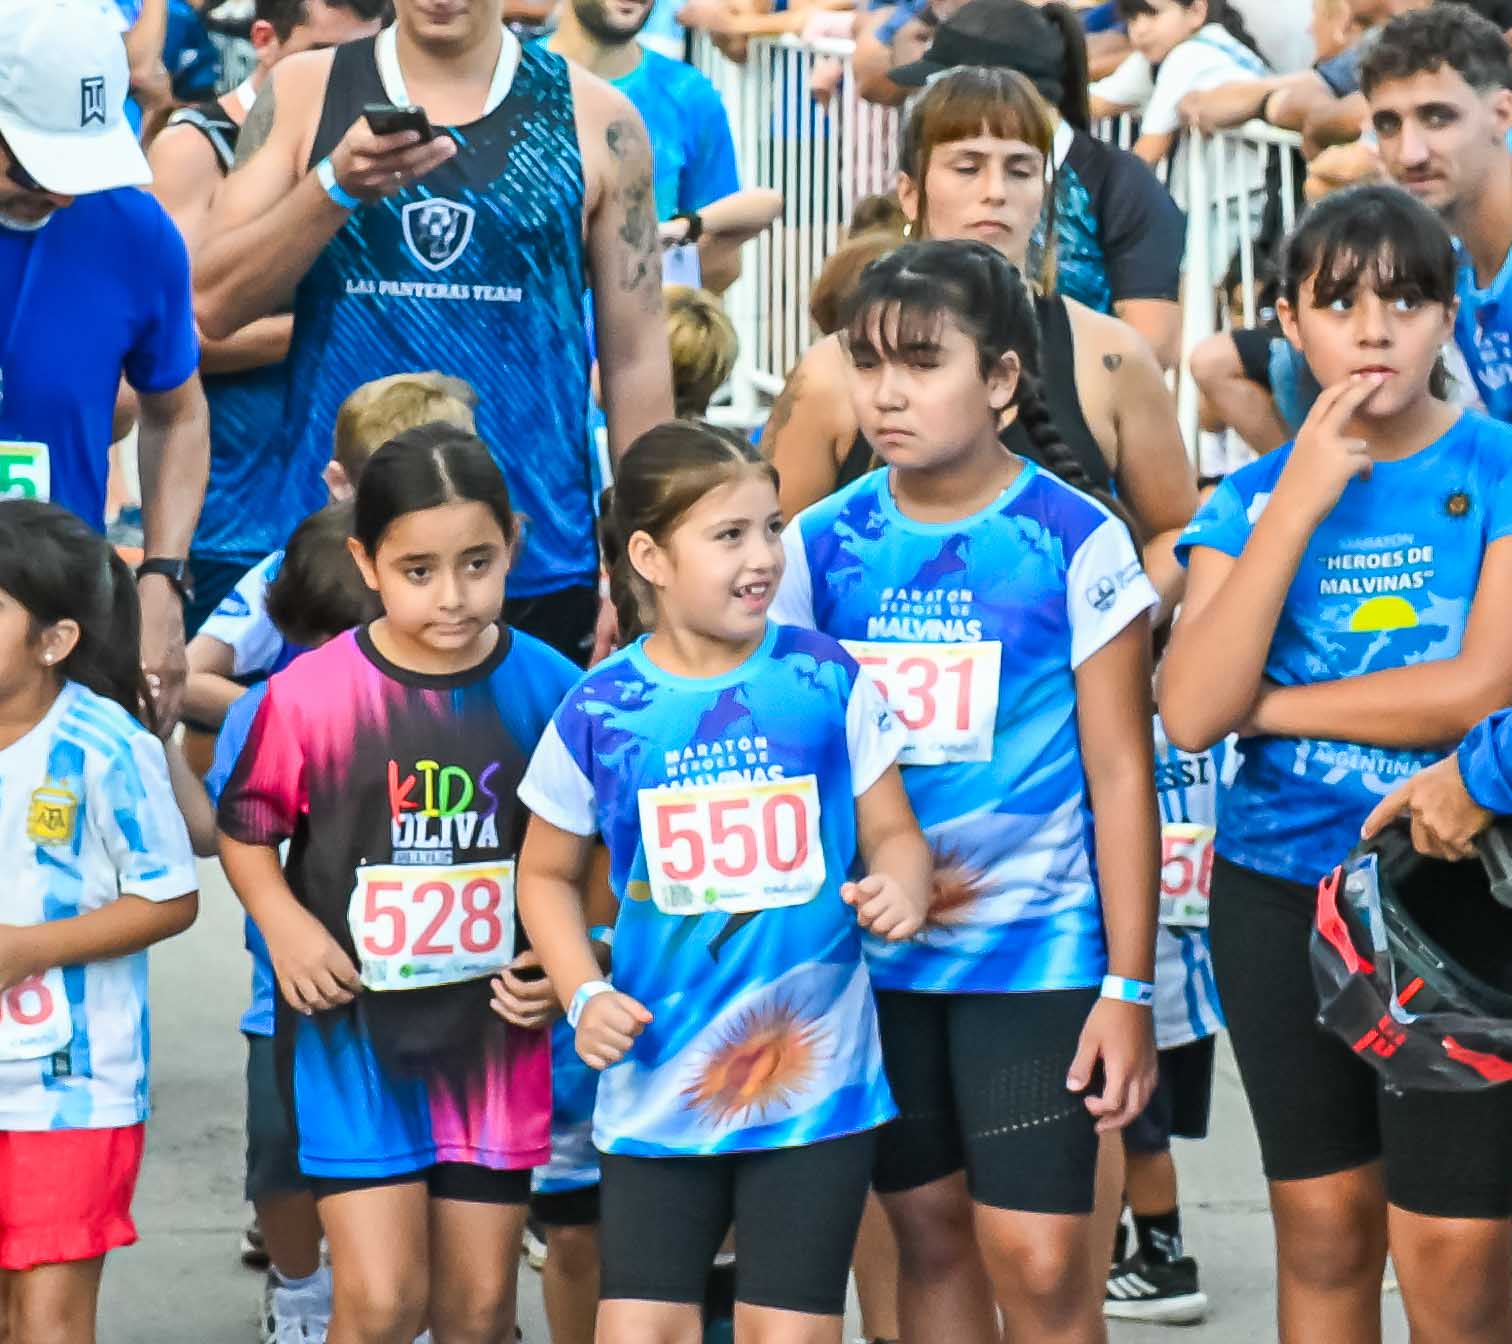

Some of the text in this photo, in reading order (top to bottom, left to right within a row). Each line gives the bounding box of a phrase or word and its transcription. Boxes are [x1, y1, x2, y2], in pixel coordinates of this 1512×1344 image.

[1407, 544, 1434, 565] DE
[866, 616, 984, 642] MALVINAS
[386, 759, 502, 826] KIDS
[656, 793, 809, 881] 550
[363, 877, 503, 956] 528
